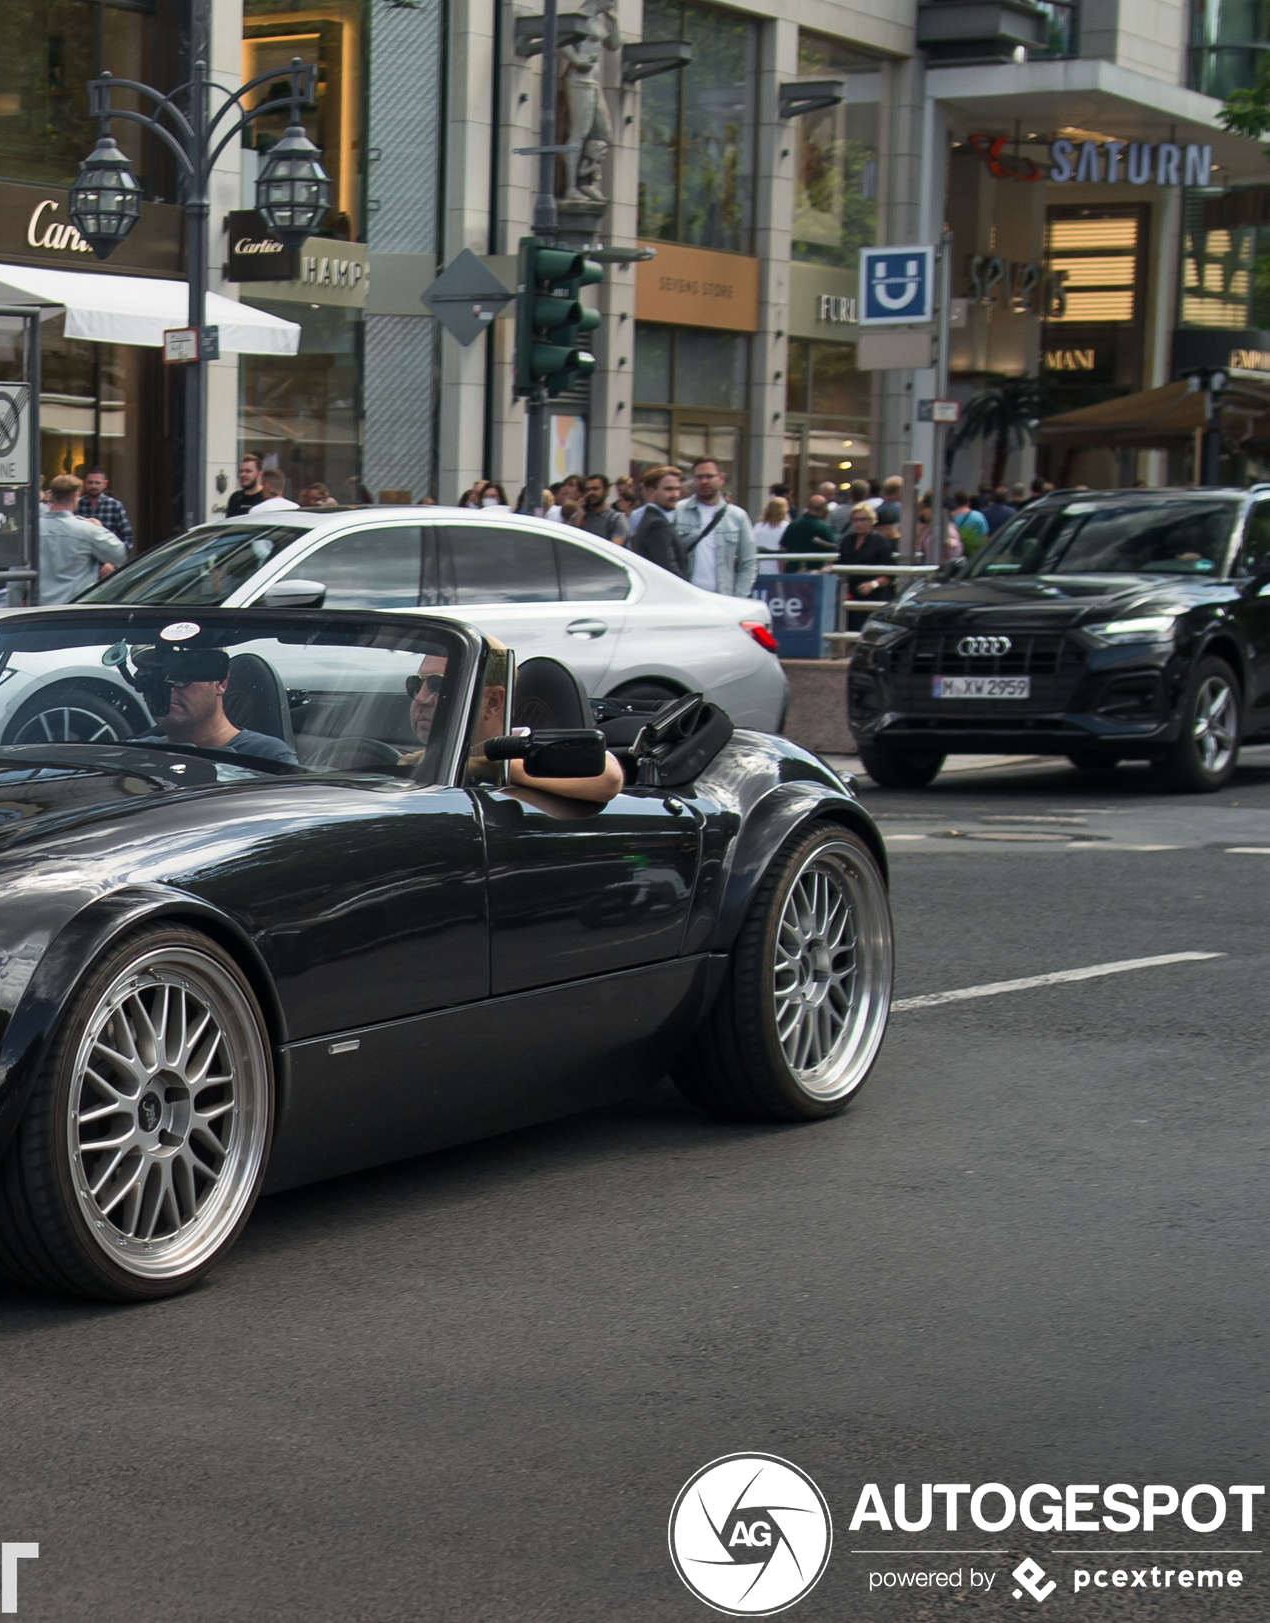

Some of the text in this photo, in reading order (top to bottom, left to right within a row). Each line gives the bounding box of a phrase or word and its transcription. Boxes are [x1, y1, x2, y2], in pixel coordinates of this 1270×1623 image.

[1049, 139, 1213, 186] SATURN
[943, 680, 1027, 696] M XW 2959
